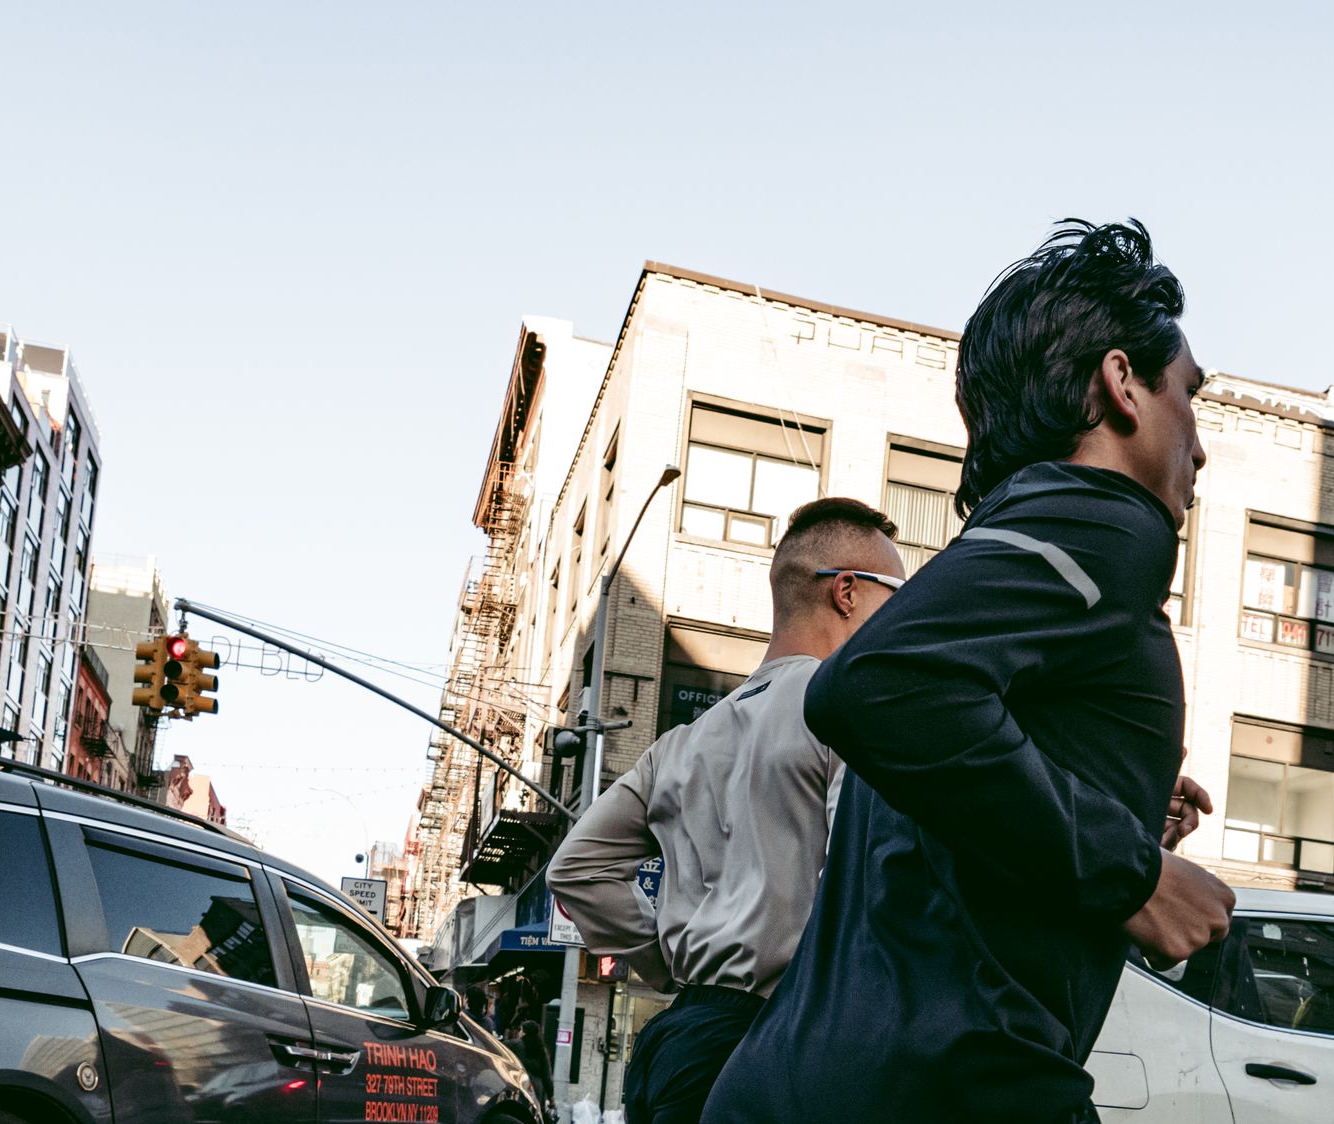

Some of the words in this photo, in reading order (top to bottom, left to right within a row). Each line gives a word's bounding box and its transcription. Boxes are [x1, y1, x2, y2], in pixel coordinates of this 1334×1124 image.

[210, 635, 242, 672] DI
[349, 890, 376, 898] SPEED
[363, 1042, 407, 1068] TRINH
[409, 1047, 437, 1071] HAO
[366, 1074, 382, 1093] 327
[383, 1075, 405, 1095] 79TH
[407, 1076, 438, 1097] STREET
[365, 1101, 407, 1122] BROOKLYN
